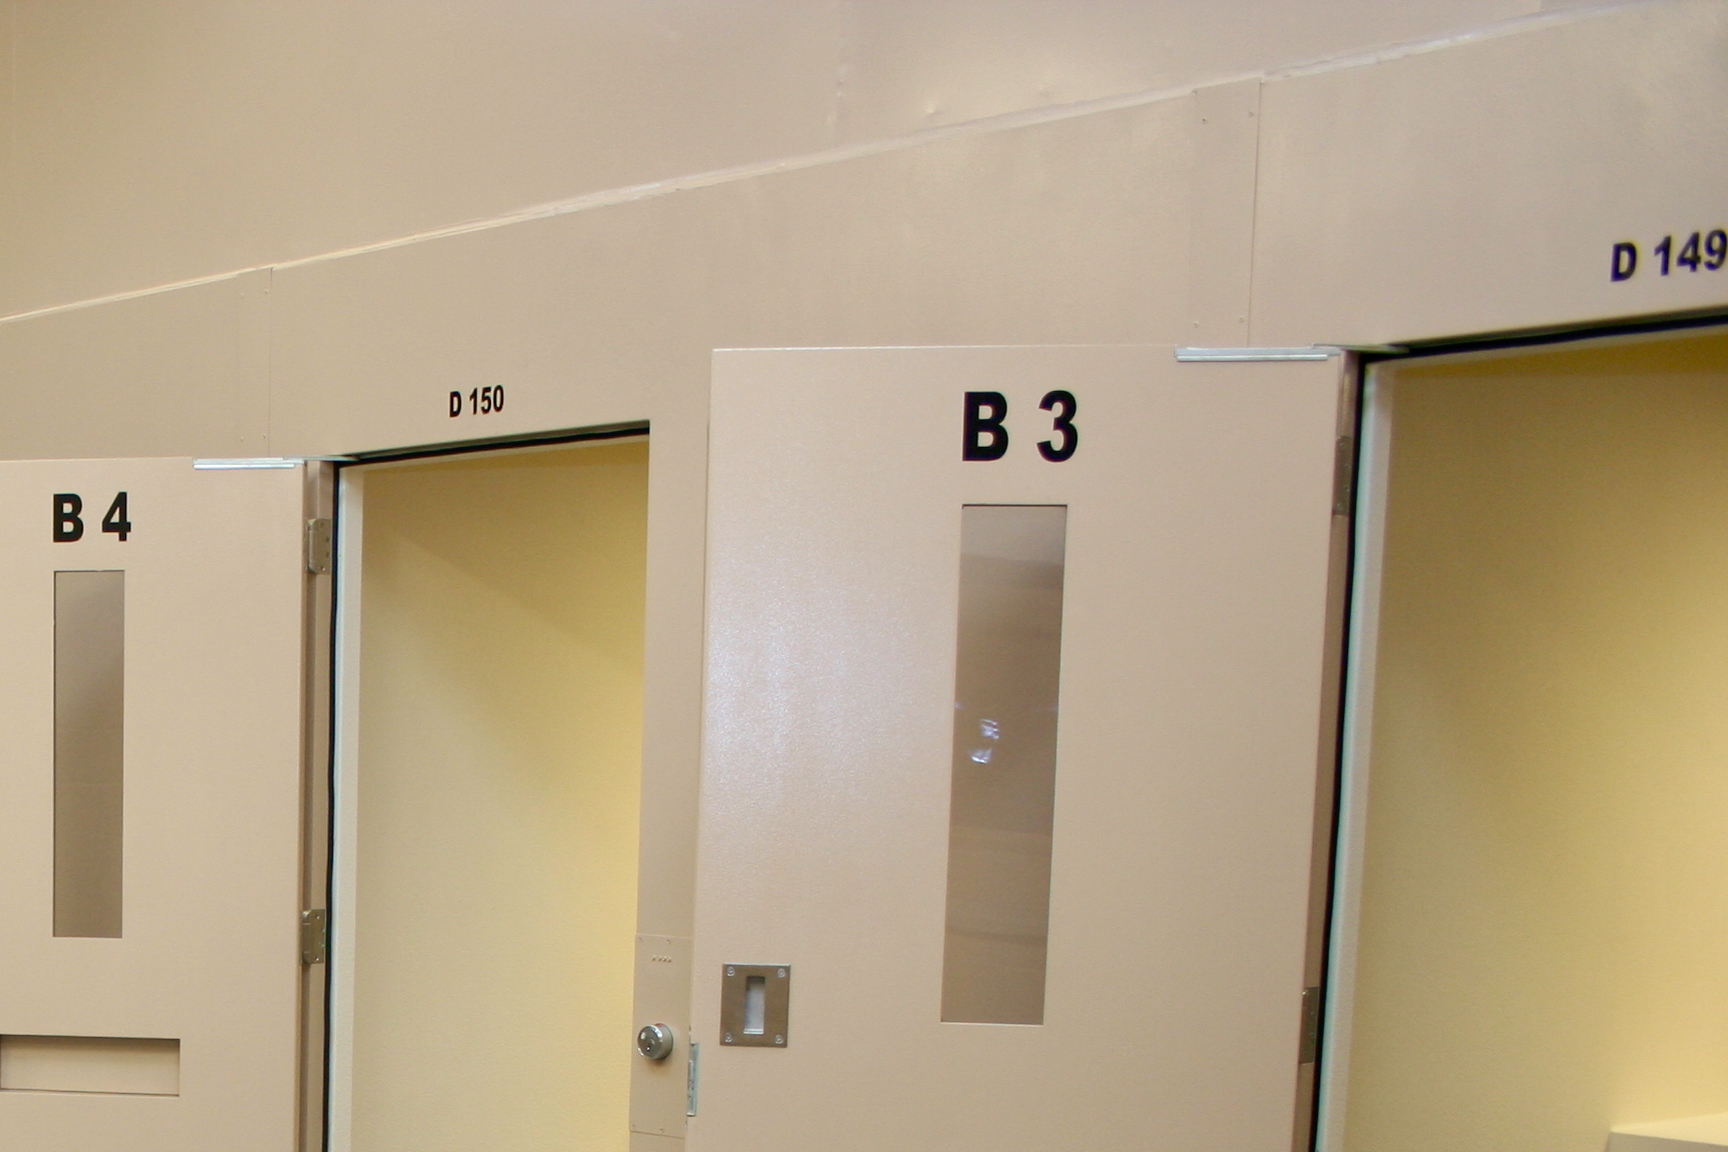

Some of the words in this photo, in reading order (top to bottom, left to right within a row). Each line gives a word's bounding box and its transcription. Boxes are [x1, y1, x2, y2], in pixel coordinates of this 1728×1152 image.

[1610, 242, 1638, 282] D
[1654, 229, 1728, 276] 149
[449, 389, 462, 418] D
[469, 384, 504, 415] 150
[962, 391, 1009, 462] B
[1037, 389, 1078, 463] 3
[53, 493, 85, 543] B
[101, 491, 132, 542] 4
